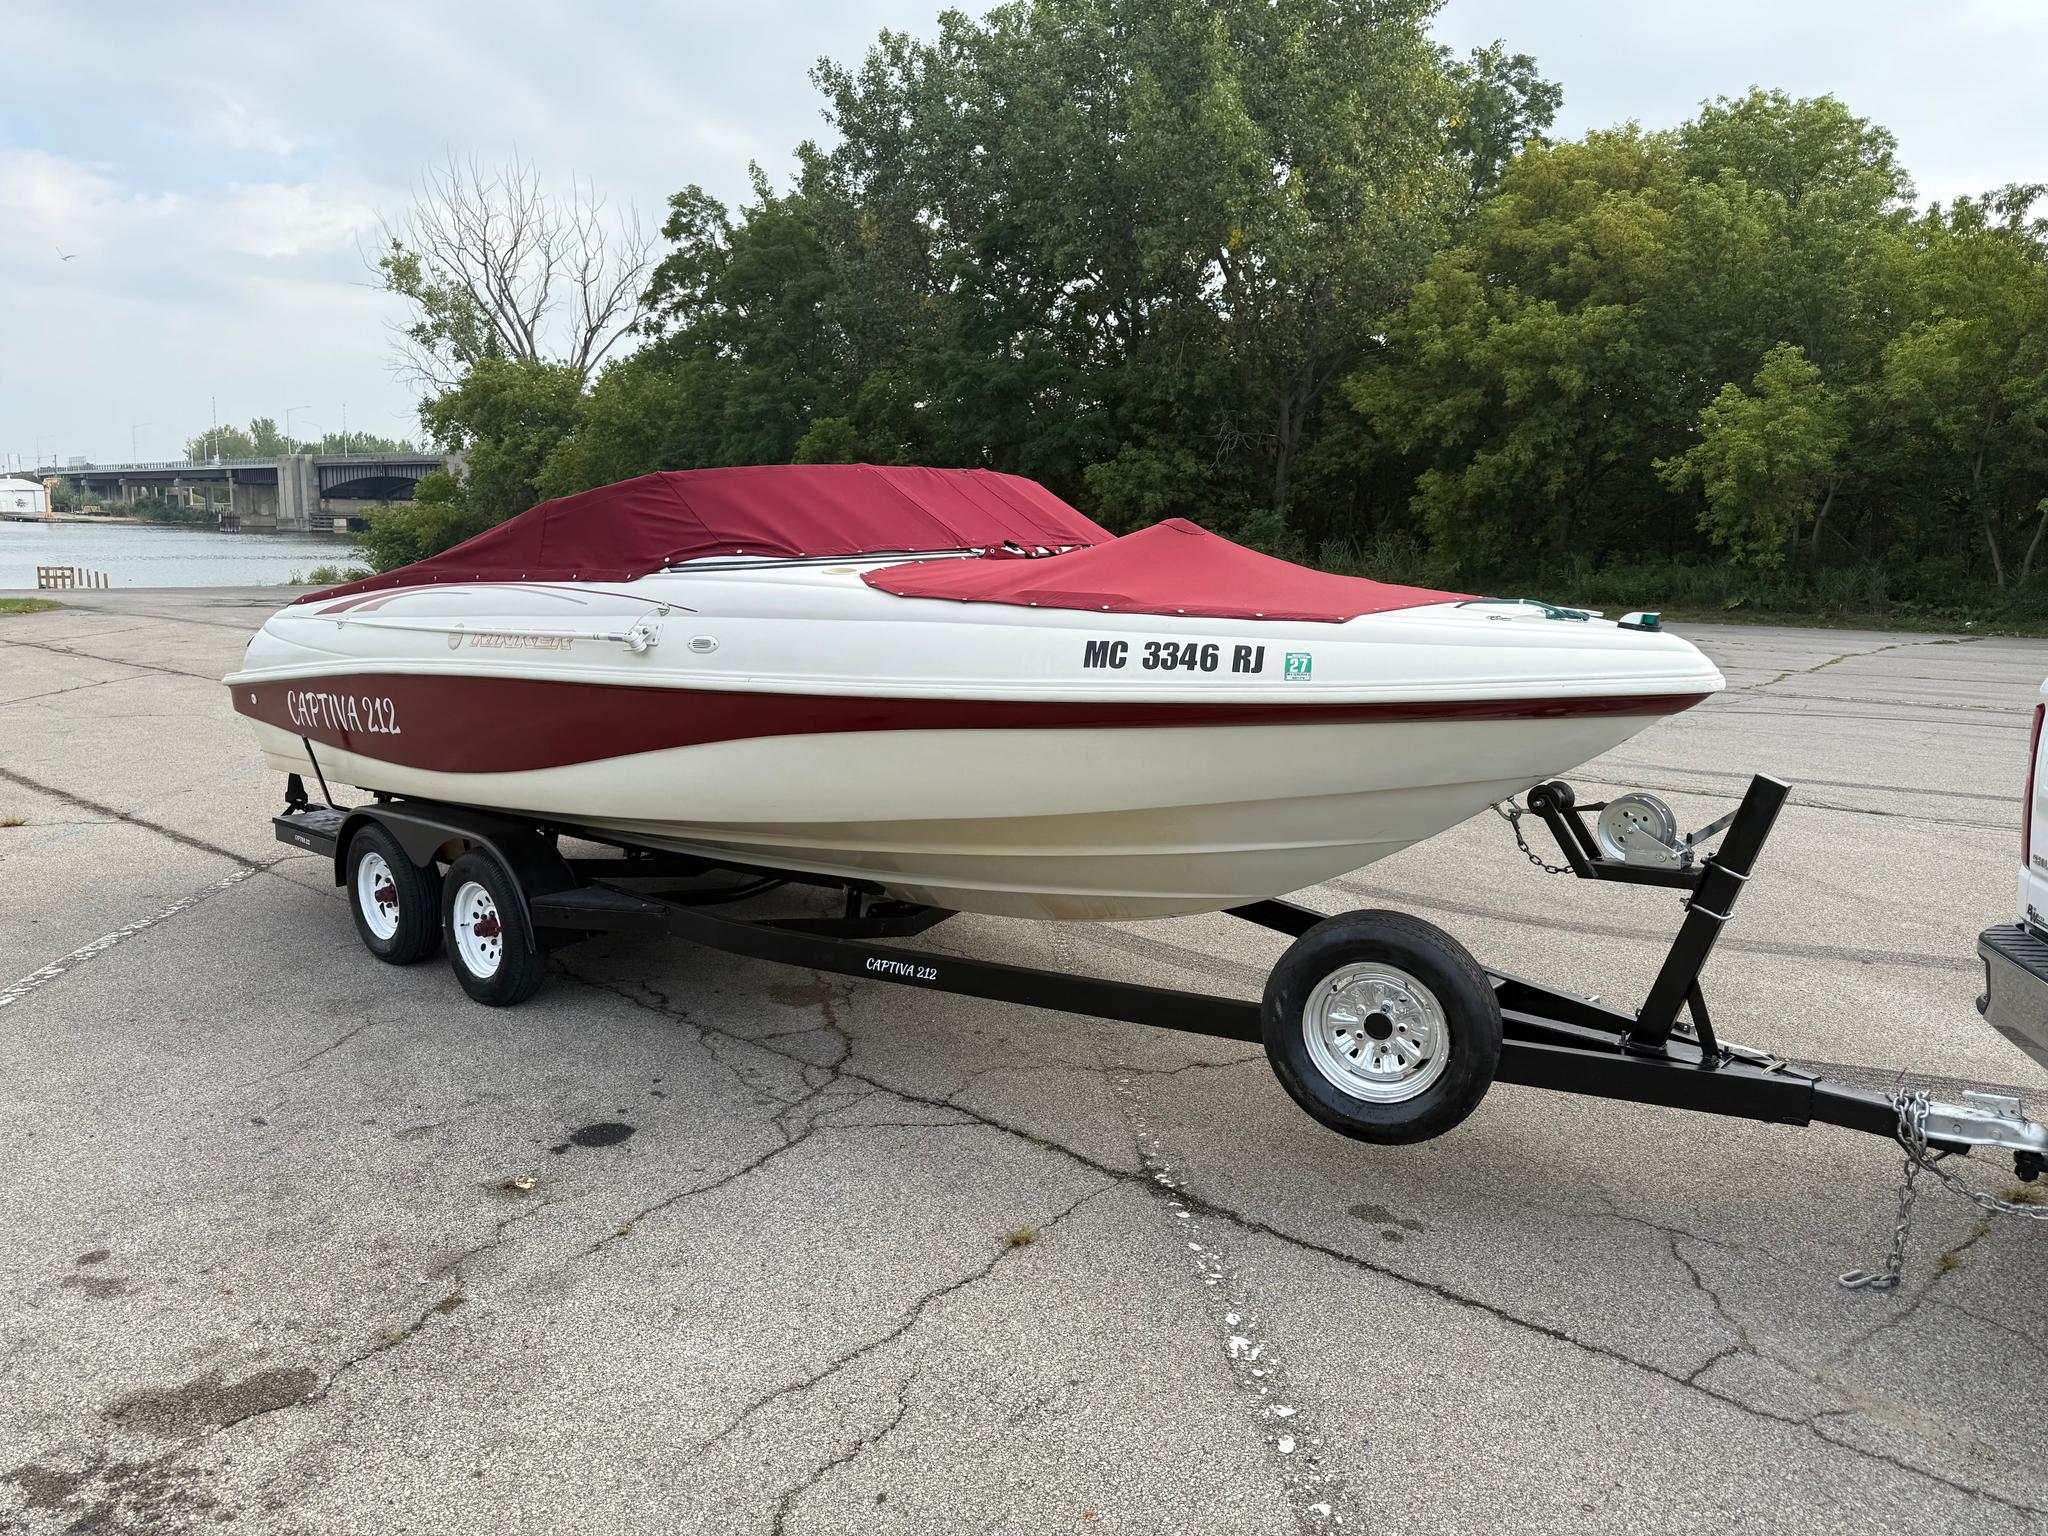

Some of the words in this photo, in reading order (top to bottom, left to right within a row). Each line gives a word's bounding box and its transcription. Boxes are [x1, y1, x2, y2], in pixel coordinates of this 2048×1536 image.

[1083, 640, 1129, 669] MC
[1142, 641, 1220, 673] 3346
[1231, 644, 1265, 673] RJ
[1289, 658, 1308, 673] 27
[287, 690, 364, 733] CAPTIVA
[361, 696, 401, 735] 212
[866, 957, 915, 977] CAPTIVA
[916, 966, 938, 980] 212
